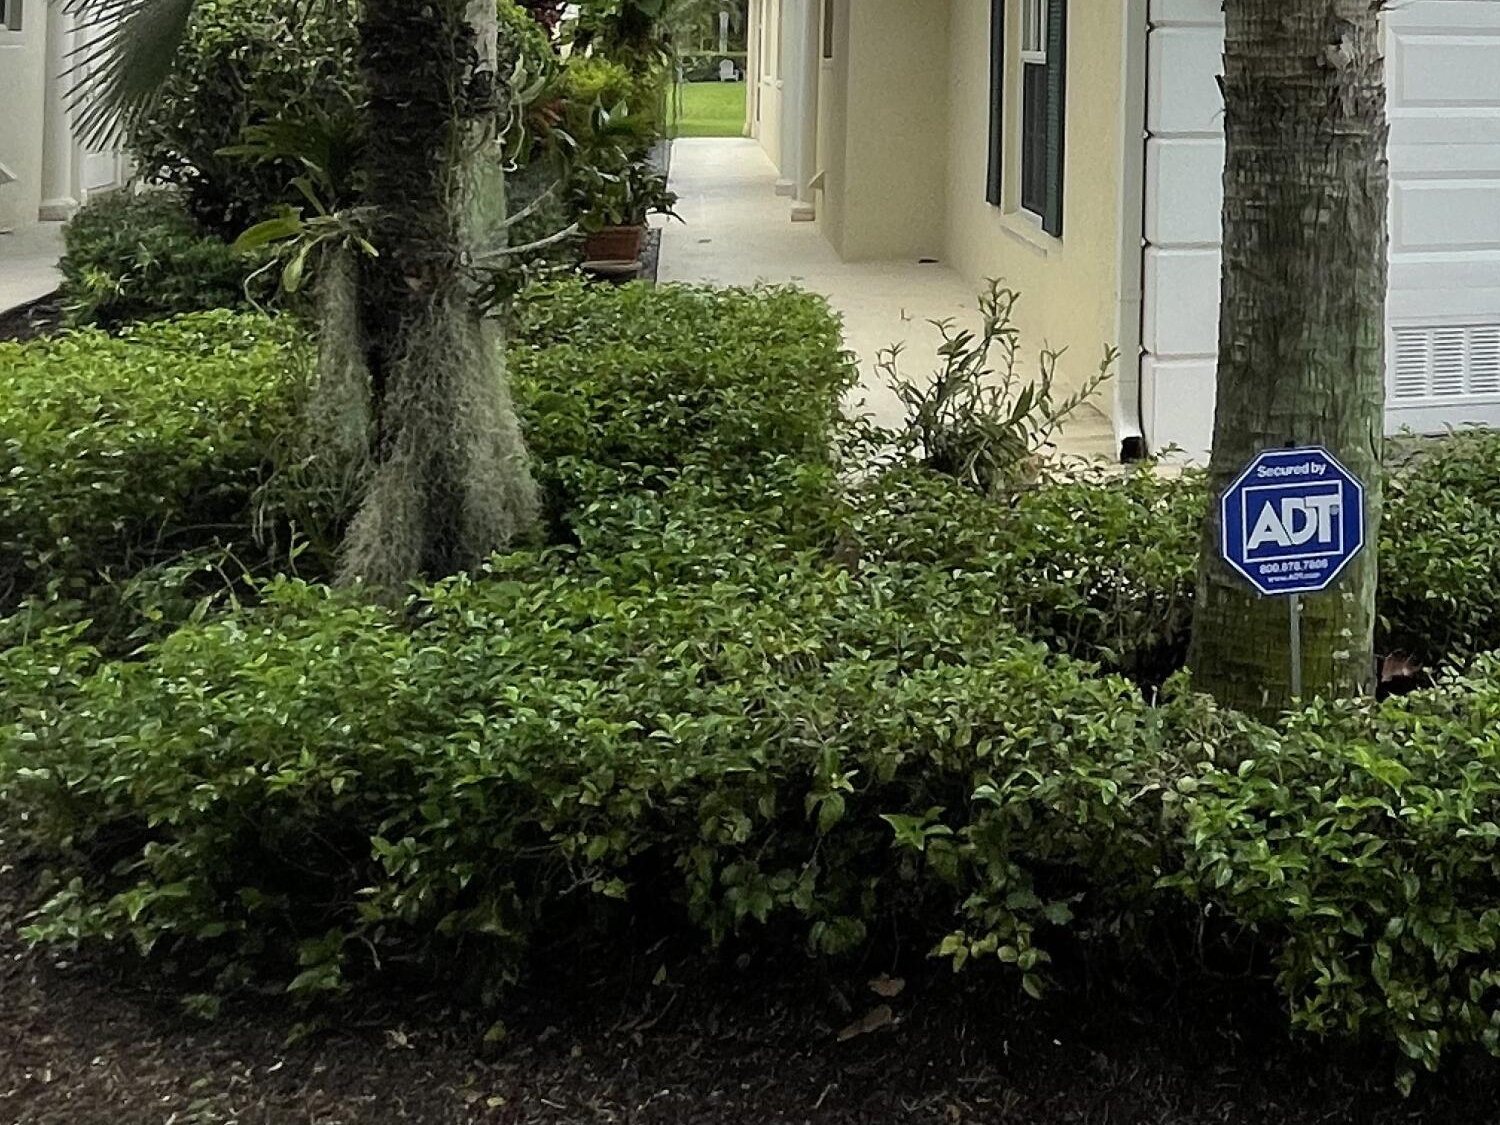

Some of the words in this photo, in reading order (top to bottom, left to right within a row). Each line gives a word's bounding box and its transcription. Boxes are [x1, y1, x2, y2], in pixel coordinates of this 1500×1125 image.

[1257, 462, 1310, 477] Secured
[1311, 461, 1327, 475] by
[1247, 494, 1339, 549] ADT
